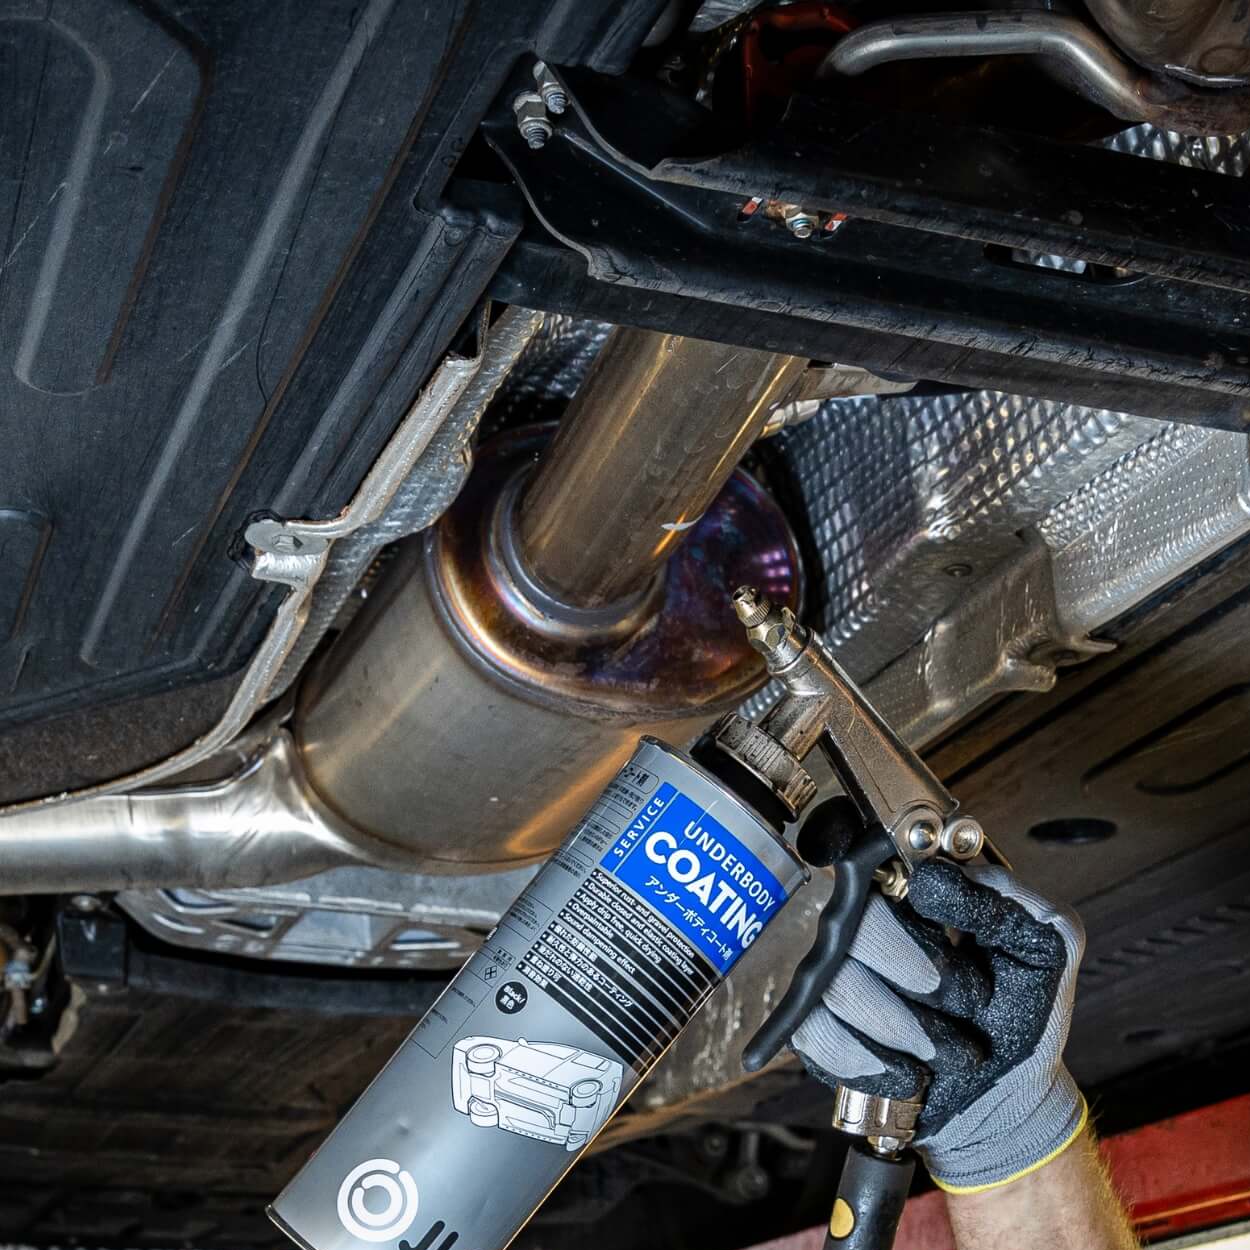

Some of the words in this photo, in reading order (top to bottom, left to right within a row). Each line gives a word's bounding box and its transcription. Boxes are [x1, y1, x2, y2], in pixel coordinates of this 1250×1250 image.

[613, 796, 666, 858] SERVICE
[683, 819, 776, 912] UNDERBODY
[571, 902, 614, 939] Overpaintable
[579, 893, 599, 910] Apply
[597, 906, 612, 920] drip
[622, 929, 643, 947] quick
[638, 943, 662, 964] drying
[587, 882, 613, 904] Durable
[610, 901, 633, 920] closed
[630, 917, 646, 930] and
[643, 927, 664, 947] elastic
[658, 944, 686, 966] coating
[681, 960, 698, 975] layer
[595, 872, 623, 895] Superior
[635, 904, 651, 918] and
[644, 915, 670, 934] gravel
[664, 931, 695, 958] protection
[644, 830, 763, 949] COATING
[563, 912, 585, 931] Sound
[579, 928, 618, 960] dampening
[616, 956, 636, 975] effect
